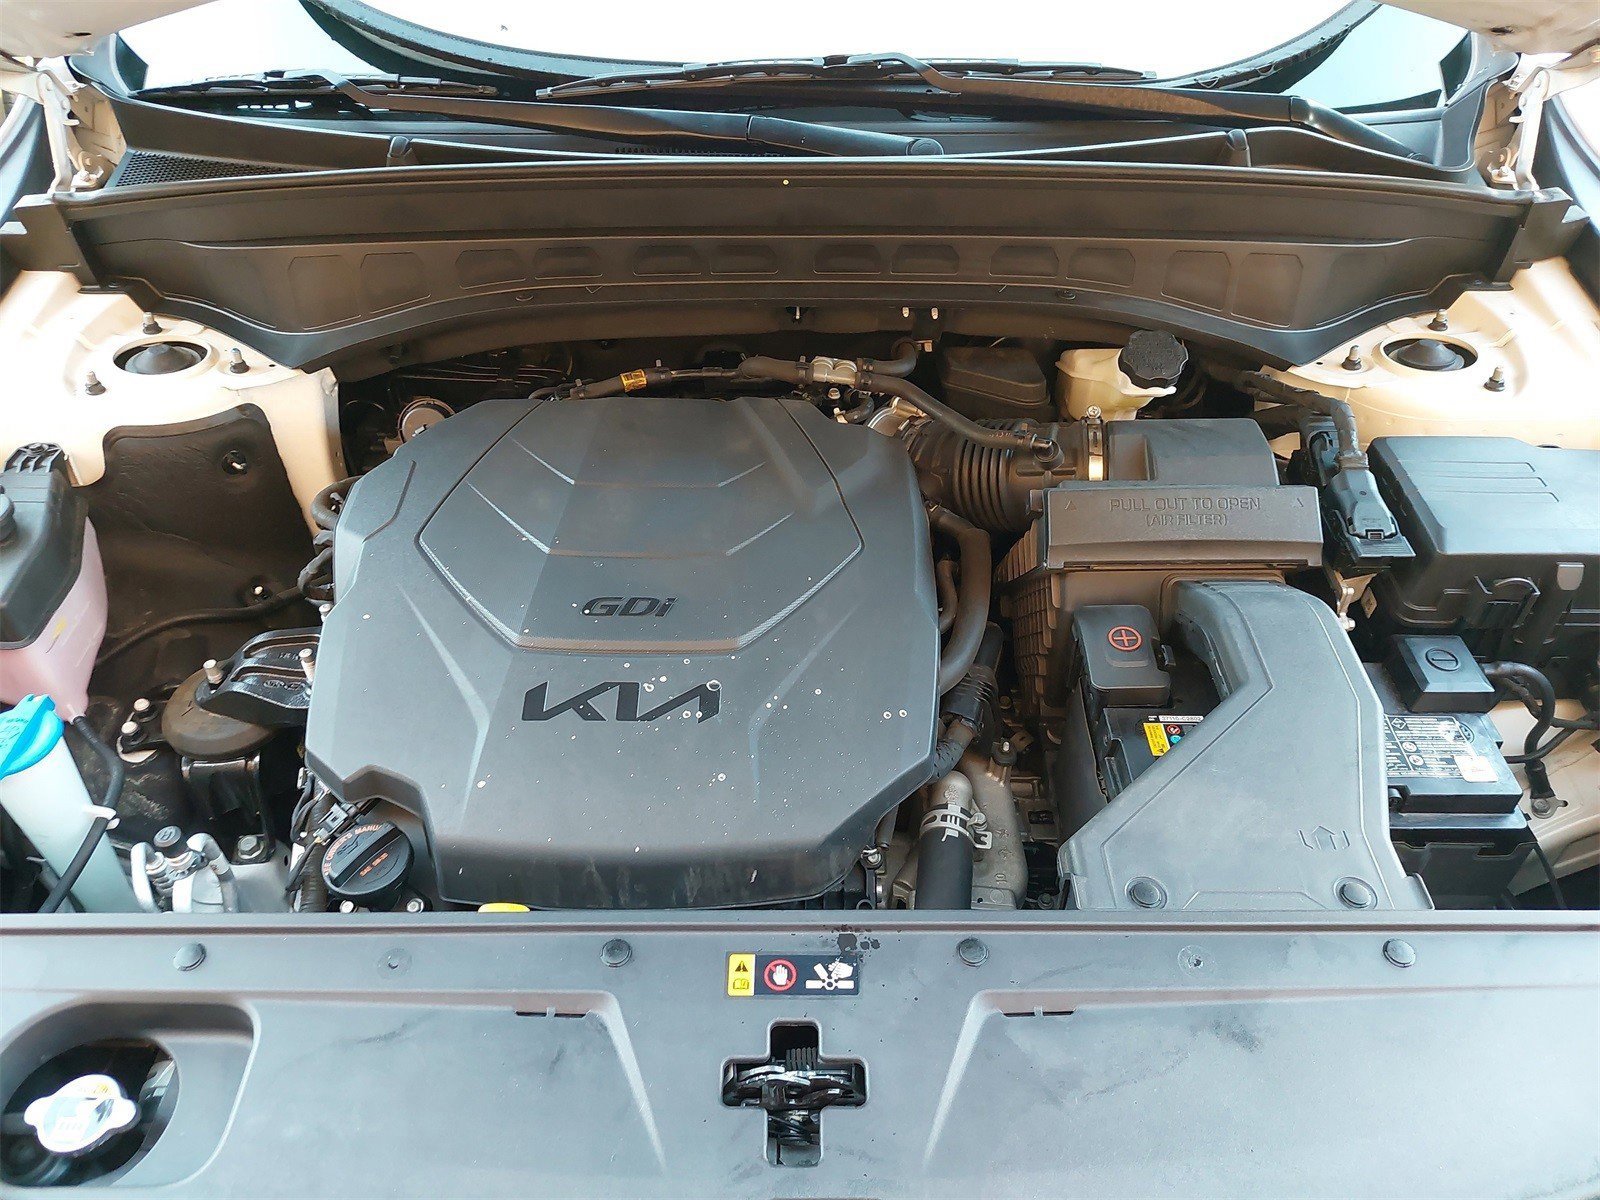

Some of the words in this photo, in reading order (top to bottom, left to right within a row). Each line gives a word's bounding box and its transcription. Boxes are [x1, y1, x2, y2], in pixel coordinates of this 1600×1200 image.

[1109, 498, 1150, 512] PULL
[1154, 498, 1188, 511] OUT
[1192, 498, 1214, 510] TO
[1217, 497, 1261, 510] OPEN
[1145, 514, 1173, 526] (AIR
[1176, 513, 1228, 526] FILTER)
[521, 681, 722, 724] KIA
